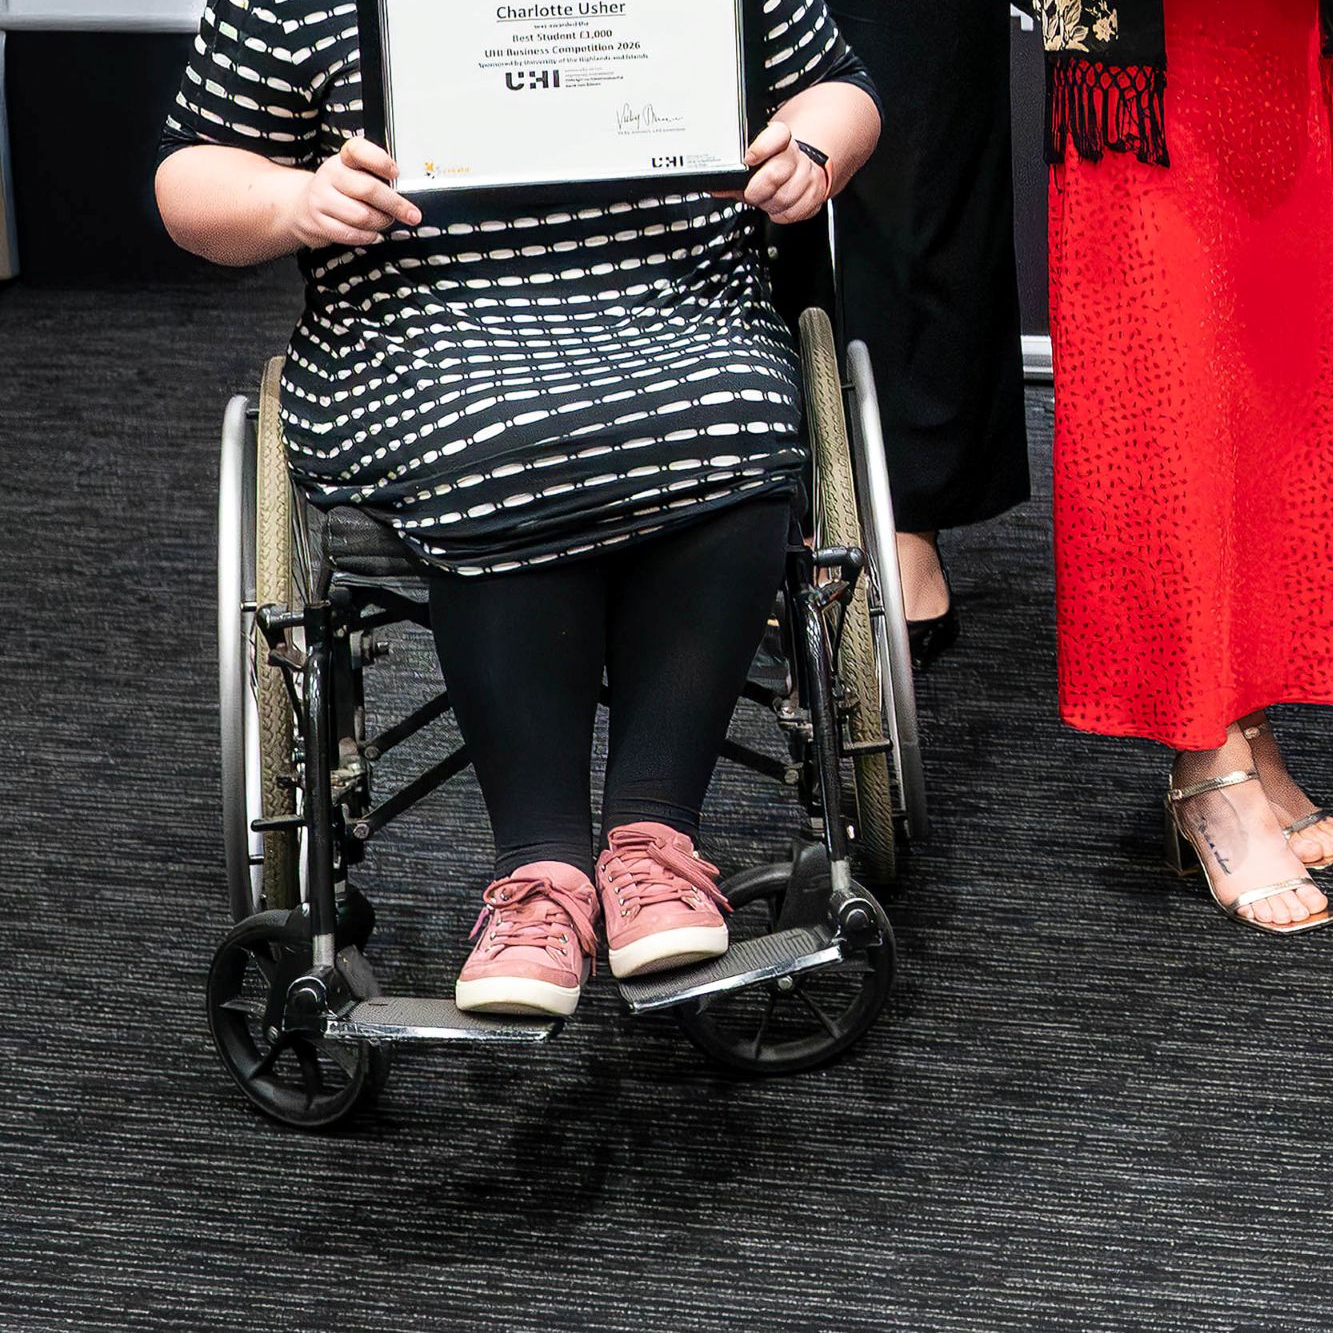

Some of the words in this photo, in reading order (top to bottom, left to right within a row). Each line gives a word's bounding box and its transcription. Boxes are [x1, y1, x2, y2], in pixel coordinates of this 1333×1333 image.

[497, 4, 572, 19] Charlotte
[579, 1, 625, 15] Usher
[538, 32, 576, 41] Student
[580, 30, 612, 40] £1,000
[485, 49, 502, 58] UHI
[507, 47, 549, 56] Business
[553, 43, 614, 55] Competition
[617, 42, 640, 50] 2026
[506, 69, 560, 91] UHI
[652, 156, 683, 168] UHI
